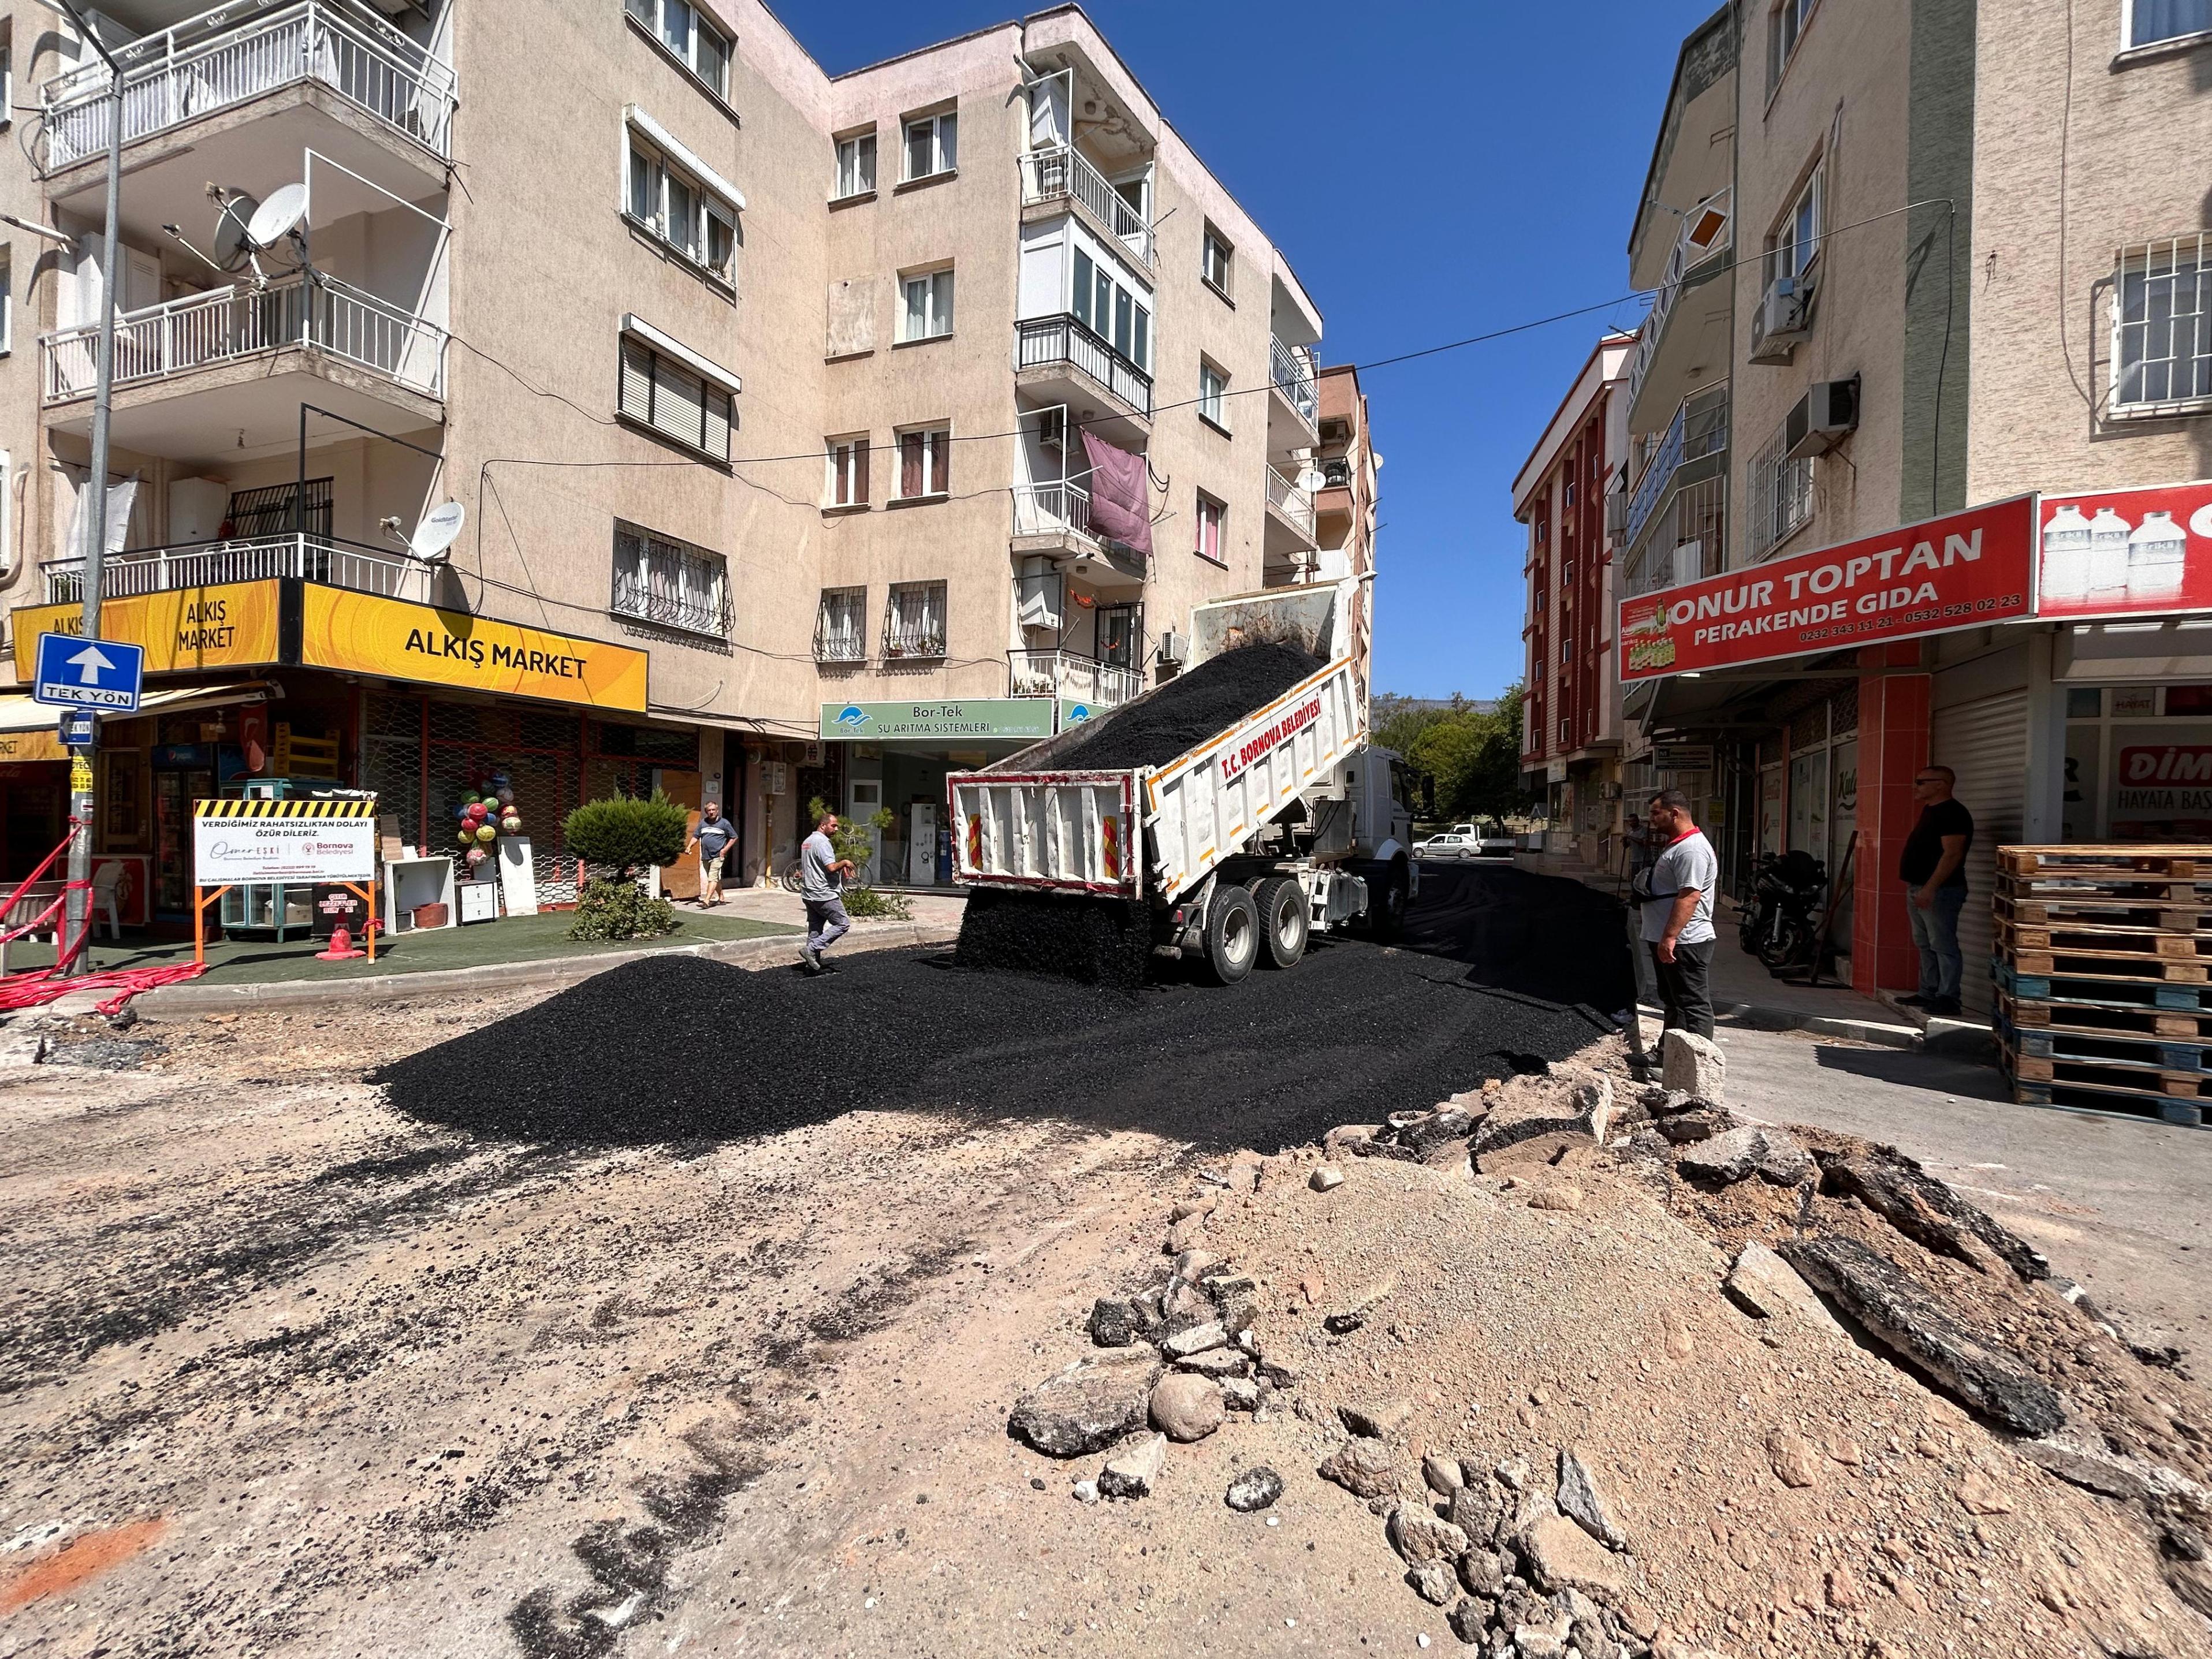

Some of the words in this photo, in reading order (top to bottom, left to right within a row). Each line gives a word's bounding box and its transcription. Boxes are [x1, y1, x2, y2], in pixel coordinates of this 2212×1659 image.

[1671, 580, 1774, 625] ONUR
[1783, 528, 1983, 600] TOPTAN
[187, 600, 226, 627] ALKIŞ
[1694, 599, 1848, 646] PERAKENDE
[1856, 581, 1938, 614] GIDA
[1800, 628, 1828, 642] 0232
[1832, 625, 1854, 636] 343
[1859, 620, 1874, 632] 11
[1877, 617, 1893, 628] 21
[1905, 610, 1939, 623] 0532
[1944, 604, 1972, 617] 528
[1976, 599, 1995, 611] 02
[2001, 594, 2021, 607] 23
[178, 626, 235, 651] MARKET
[405, 628, 485, 669] ALKIŞ
[492, 643, 587, 680] MARKET
[46, 686, 83, 700] TEK
[90, 691, 129, 705] YÖN
[2115, 699, 2151, 709] HAYAT
[913, 705, 963, 717] Bor-Tek
[878, 724, 890, 733] SU
[893, 723, 931, 733] ARITMA
[1222, 754, 1241, 780] T.C.
[1240, 725, 1282, 766] BORNOVA
[1281, 692, 1321, 738] BELEDİYESİ
[2118, 790, 2174, 810] HAYATA
